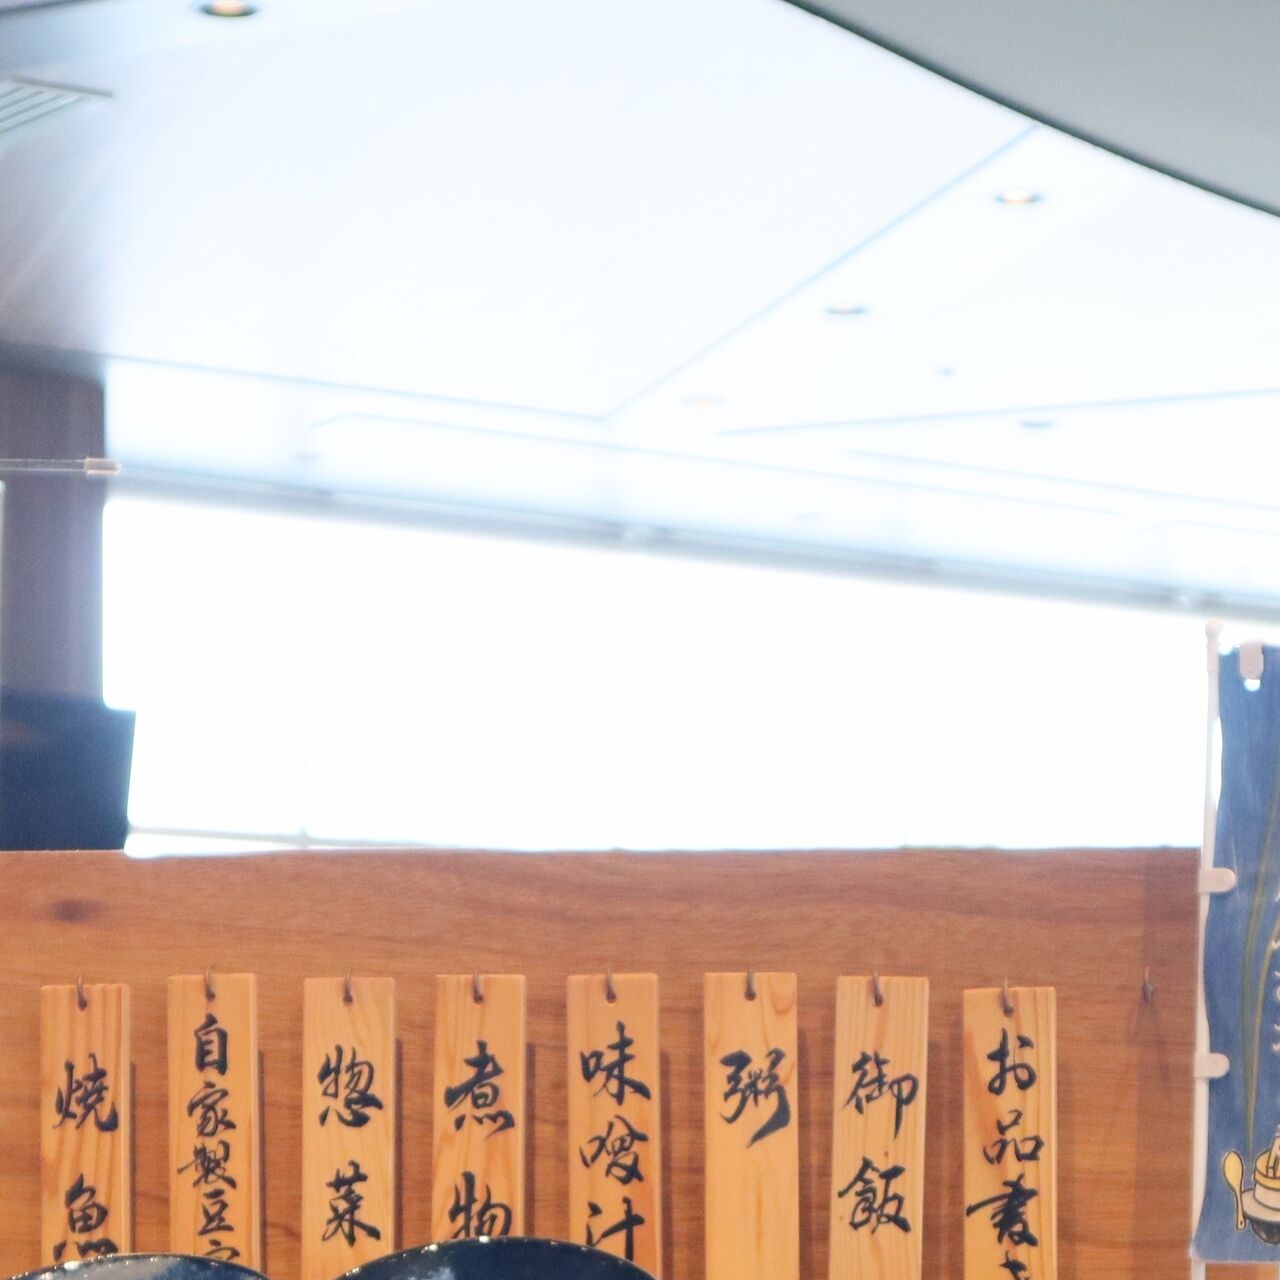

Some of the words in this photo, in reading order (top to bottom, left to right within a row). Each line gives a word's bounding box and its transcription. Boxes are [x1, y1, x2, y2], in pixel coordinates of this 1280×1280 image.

[317, 1044, 384, 1247] 惣菜
[443, 1039, 516, 1239] 煮物
[579, 1021, 651, 1261] 味噌汁
[719, 1047, 792, 1148] 粥
[840, 1050, 919, 1235] 御飯
